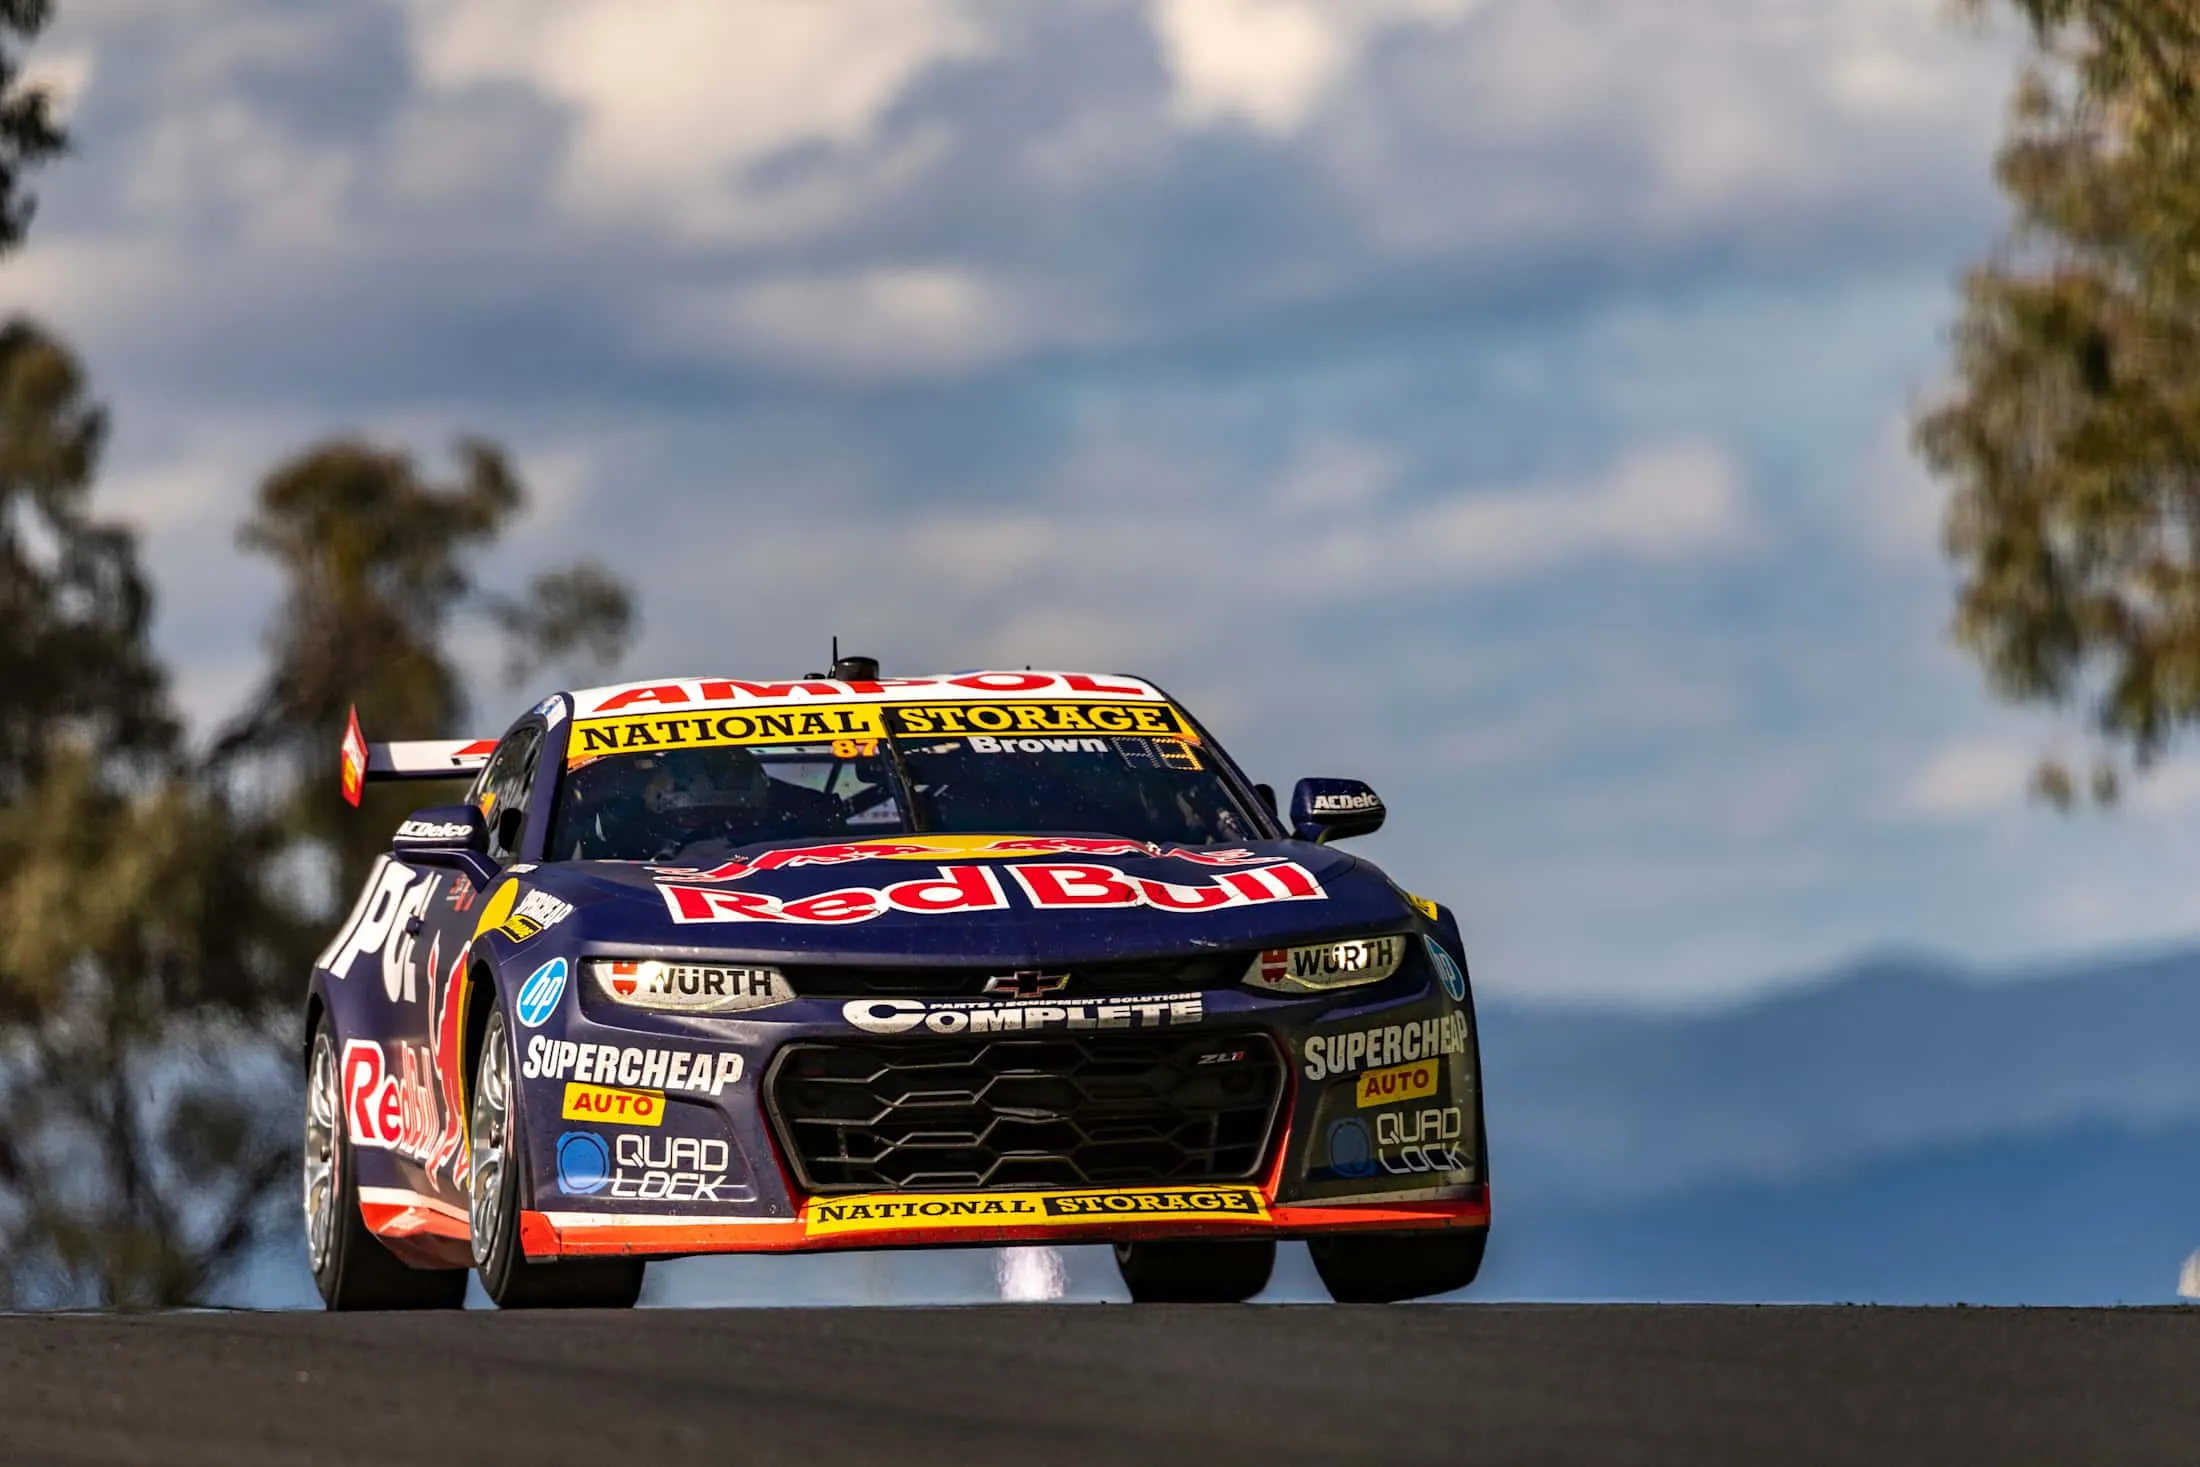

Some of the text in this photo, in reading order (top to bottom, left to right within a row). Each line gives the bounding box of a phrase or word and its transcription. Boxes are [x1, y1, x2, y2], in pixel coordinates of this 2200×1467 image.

[592, 672, 1144, 712] AMPOL
[580, 704, 1170, 751] NATIONAL STORAGE
[966, 736, 1109, 754] Brown
[832, 738, 879, 759] 87
[1314, 791, 1380, 810] ACDelc
[654, 862, 1328, 925] Red Bull
[519, 957, 566, 1027] hp
[842, 999, 1202, 1034] COMPLETE
[1303, 1009, 1469, 1081] SUPERCHEAP
[522, 1034, 745, 1096] SUPERCHEAP
[1364, 1068, 1430, 1098] AUTO
[572, 1091, 654, 1117] AUTO
[1376, 1106, 1462, 1146] QUAD
[615, 1133, 729, 1173] QUAD
[1378, 1141, 1467, 1174] LOCK
[610, 1167, 728, 1202] LOCK
[817, 1191, 1249, 1224] NATIONAL STORAGE
